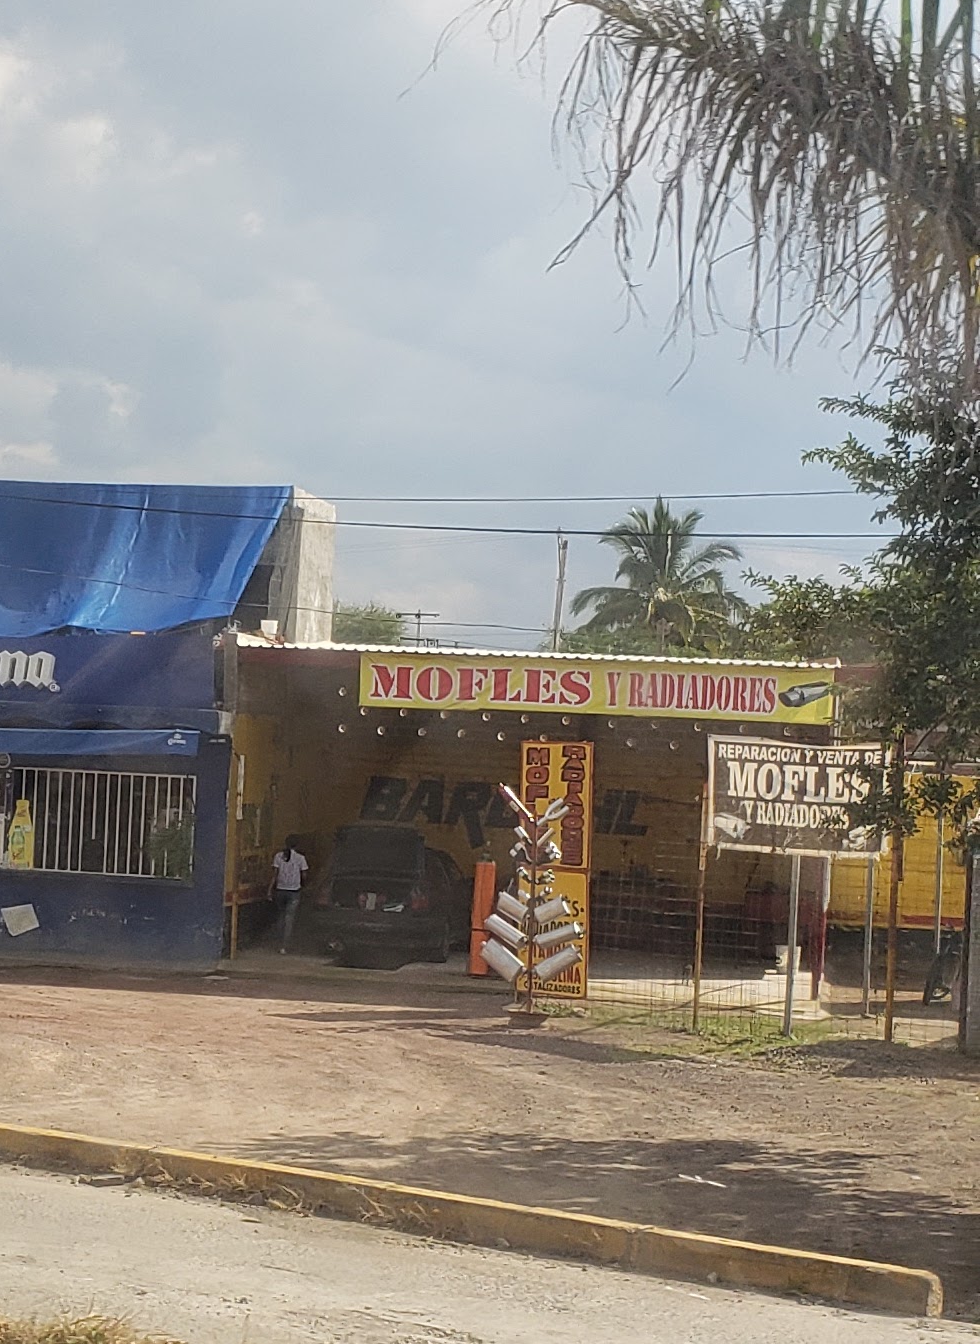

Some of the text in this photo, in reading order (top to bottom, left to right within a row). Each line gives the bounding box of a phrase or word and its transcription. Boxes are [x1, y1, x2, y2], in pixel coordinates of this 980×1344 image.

[370, 665, 778, 714] MOFLES Y RADIADORES
[719, 744, 882, 765] REPARACION Y VENTA DE
[728, 761, 871, 804] MOFLES
[742, 800, 753, 824] Y
[524, 980, 581, 995] CTALIZADORES
